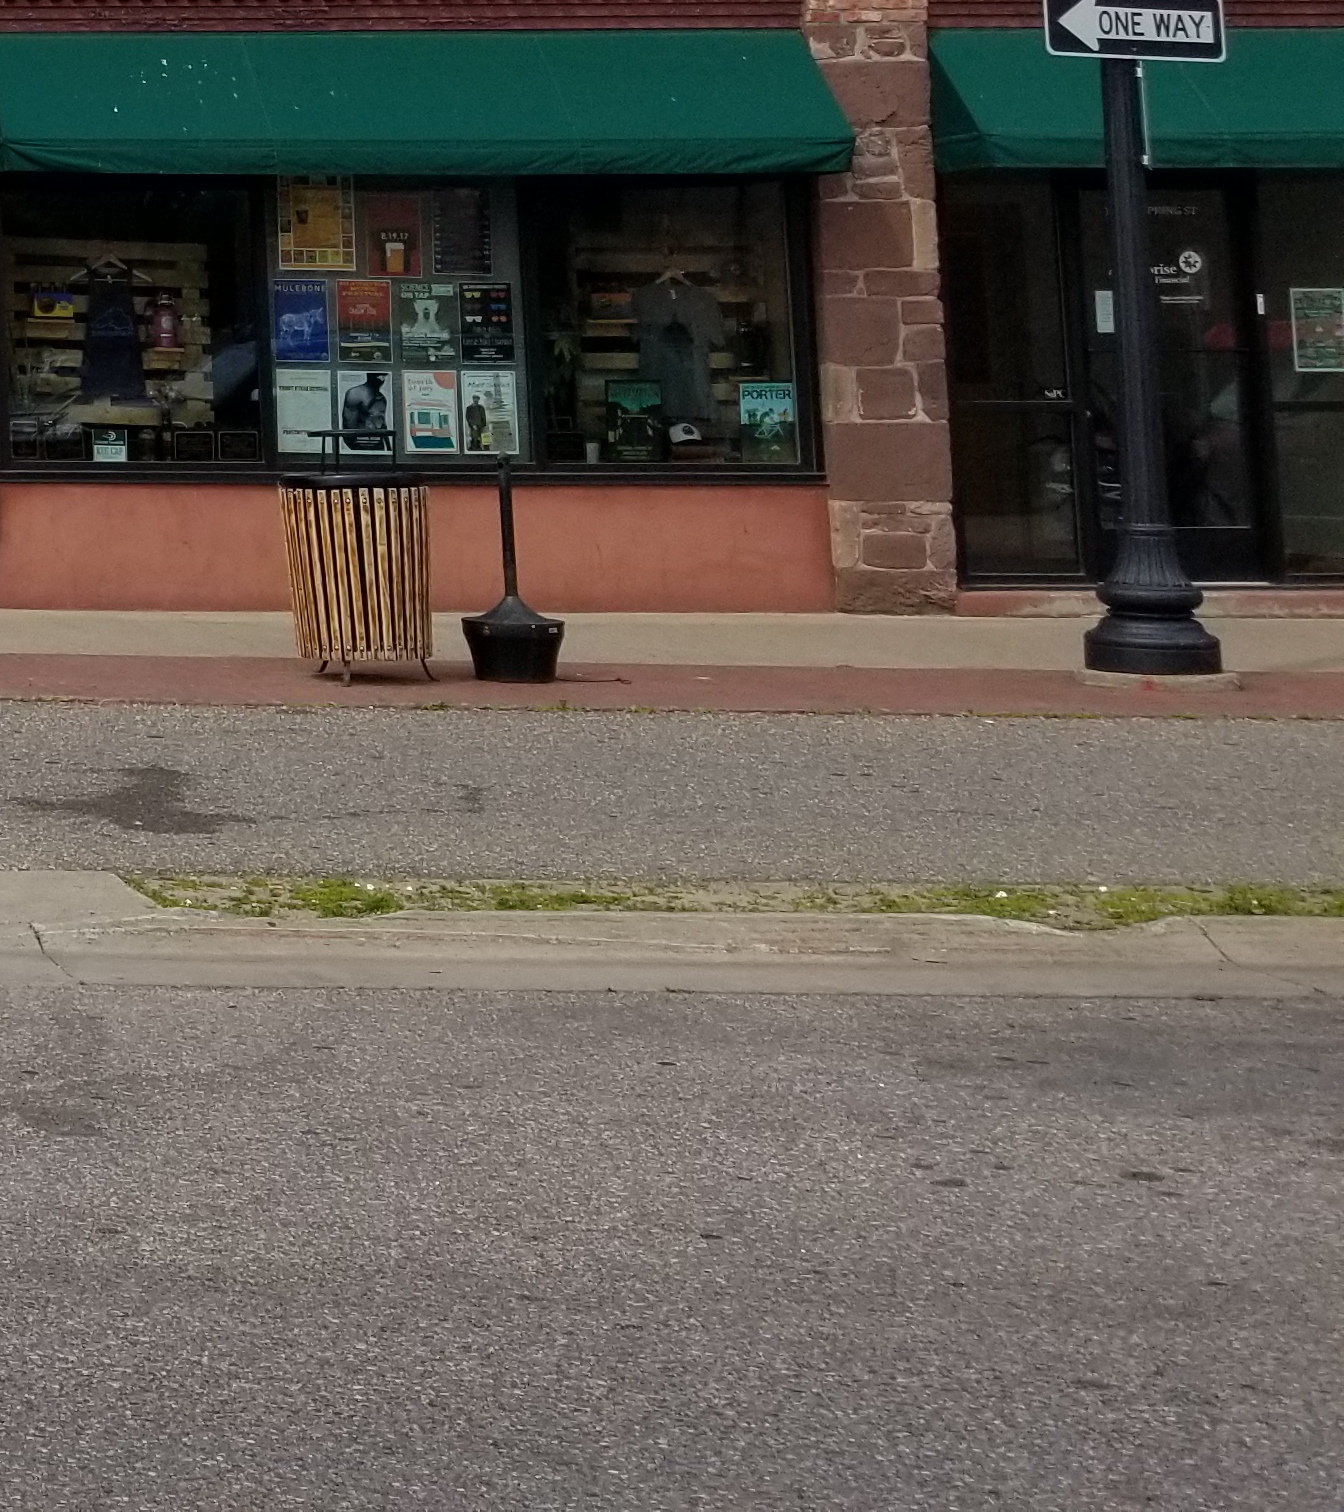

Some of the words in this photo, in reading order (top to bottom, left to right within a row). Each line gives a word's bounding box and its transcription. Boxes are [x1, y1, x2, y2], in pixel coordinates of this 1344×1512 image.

[1098, 9, 1146, 38] ONE
[1153, 11, 1207, 39] WAY
[274, 284, 325, 293] MULEBONE
[741, 389, 792, 400] PORTER
